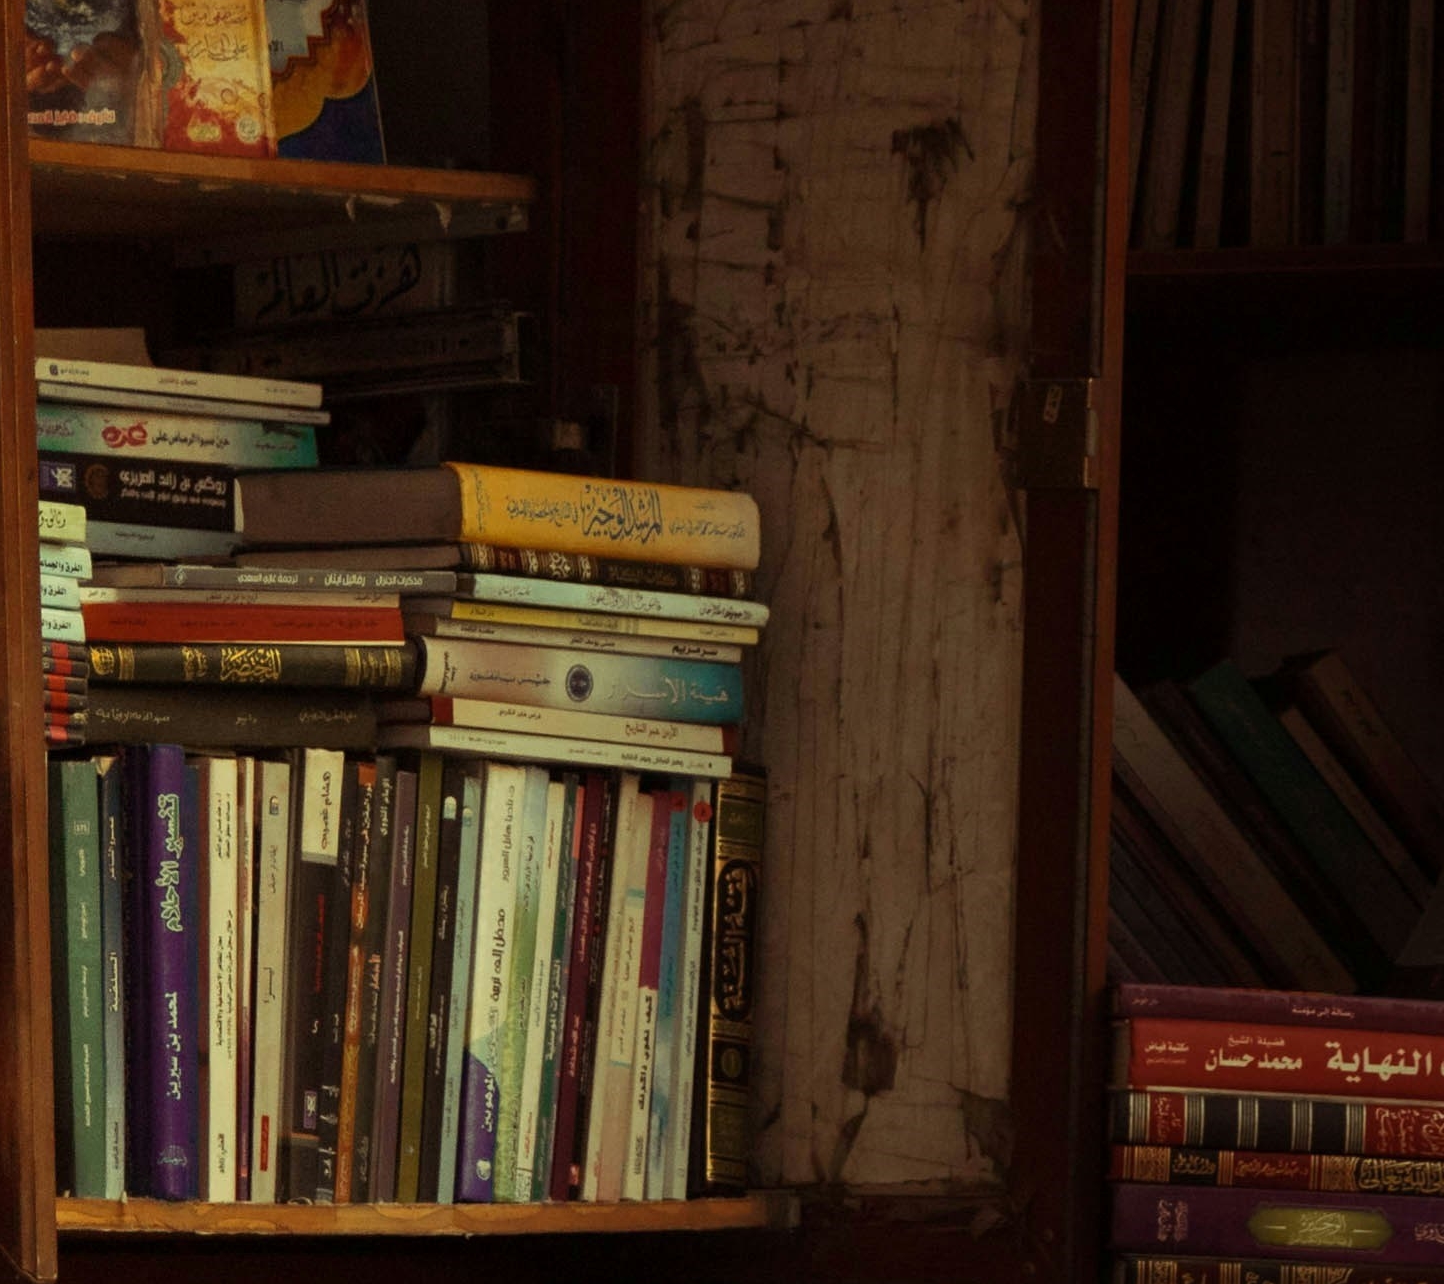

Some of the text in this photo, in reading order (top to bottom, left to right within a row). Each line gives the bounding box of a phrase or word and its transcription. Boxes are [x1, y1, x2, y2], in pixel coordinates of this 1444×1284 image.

[156, 792, 184, 859] تفسير
[164, 1032, 181, 1053] بن
[1203, 1045, 1305, 1075] محمد حسان
[1324, 1041, 1433, 1084] النهاية
[164, 1052, 182, 1102] سيرين
